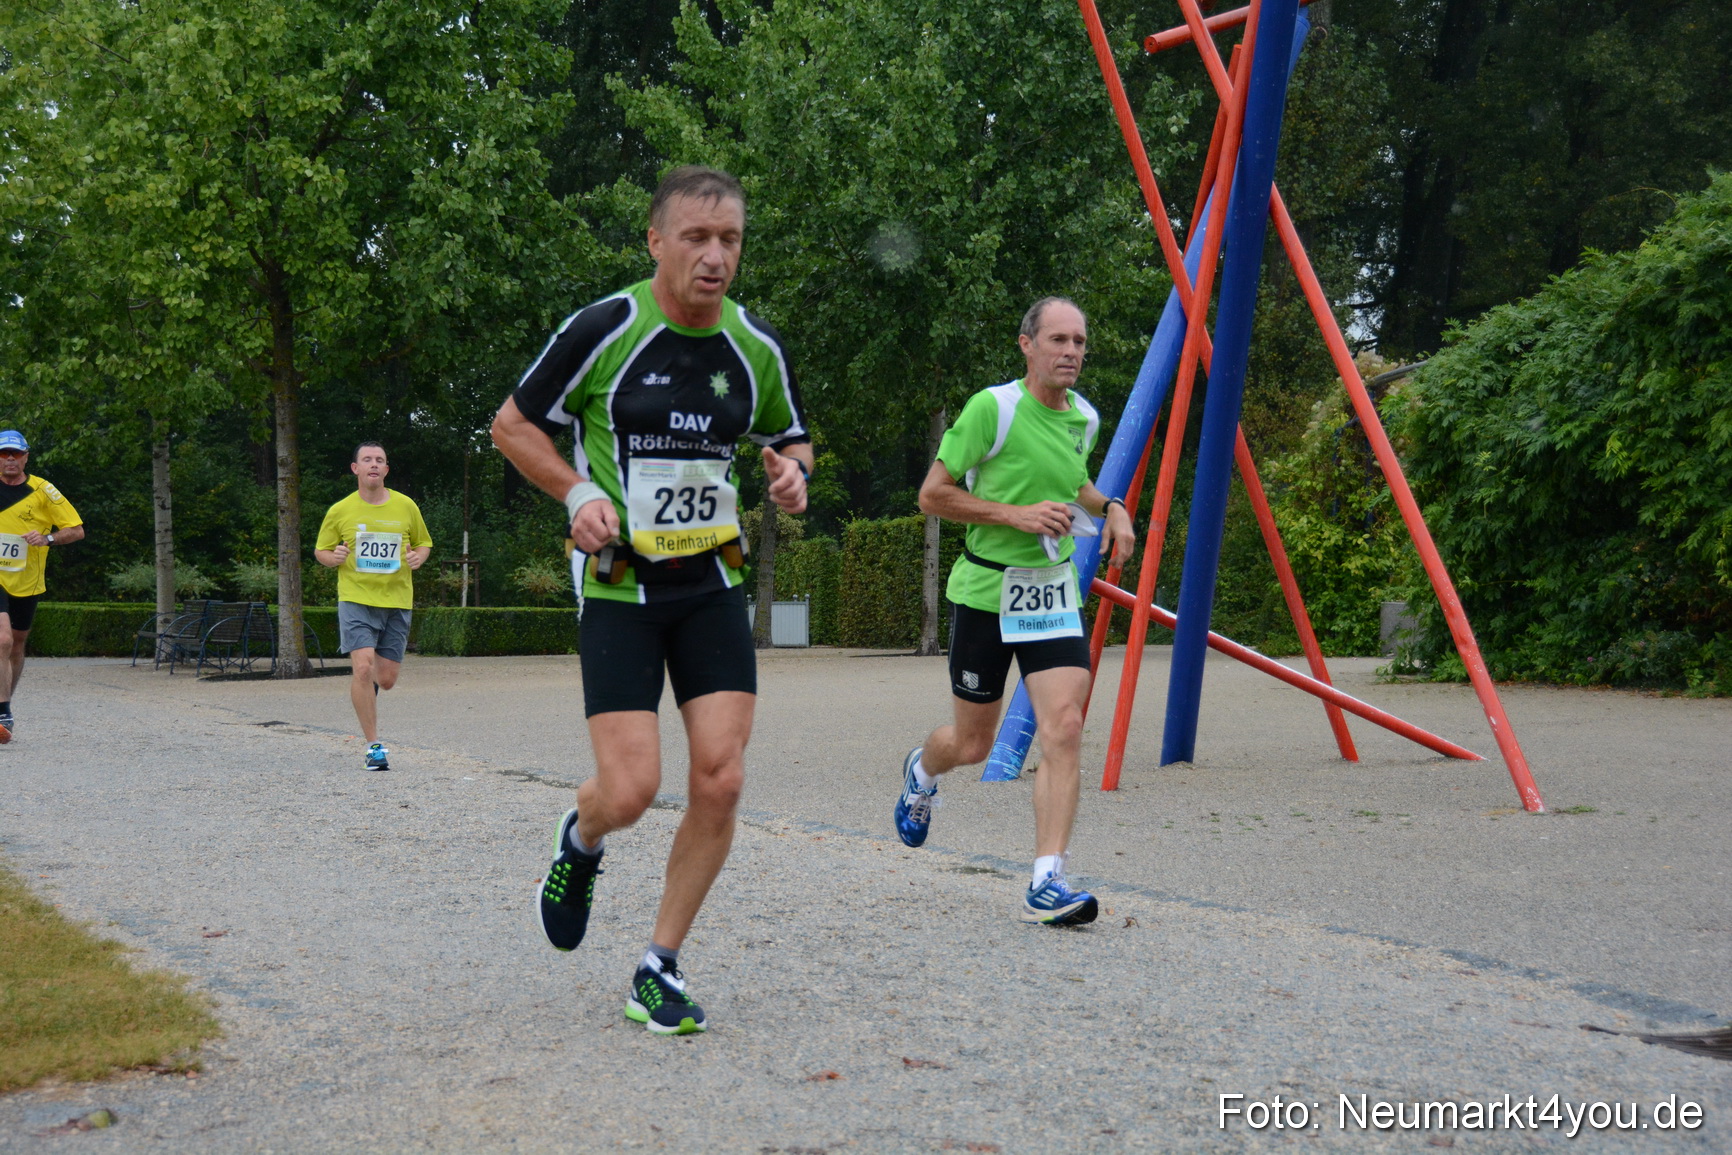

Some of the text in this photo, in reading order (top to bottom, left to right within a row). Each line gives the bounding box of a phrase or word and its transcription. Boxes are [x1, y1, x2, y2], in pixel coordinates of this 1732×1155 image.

[670, 411, 712, 433] DAV
[654, 486, 719, 525] 235
[361, 541, 398, 558] 2037
[655, 533, 718, 552] Reinhard
[365, 560, 391, 568] Thorsten
[1009, 582, 1067, 612] 2361
[1018, 616, 1065, 631] Reinhard
